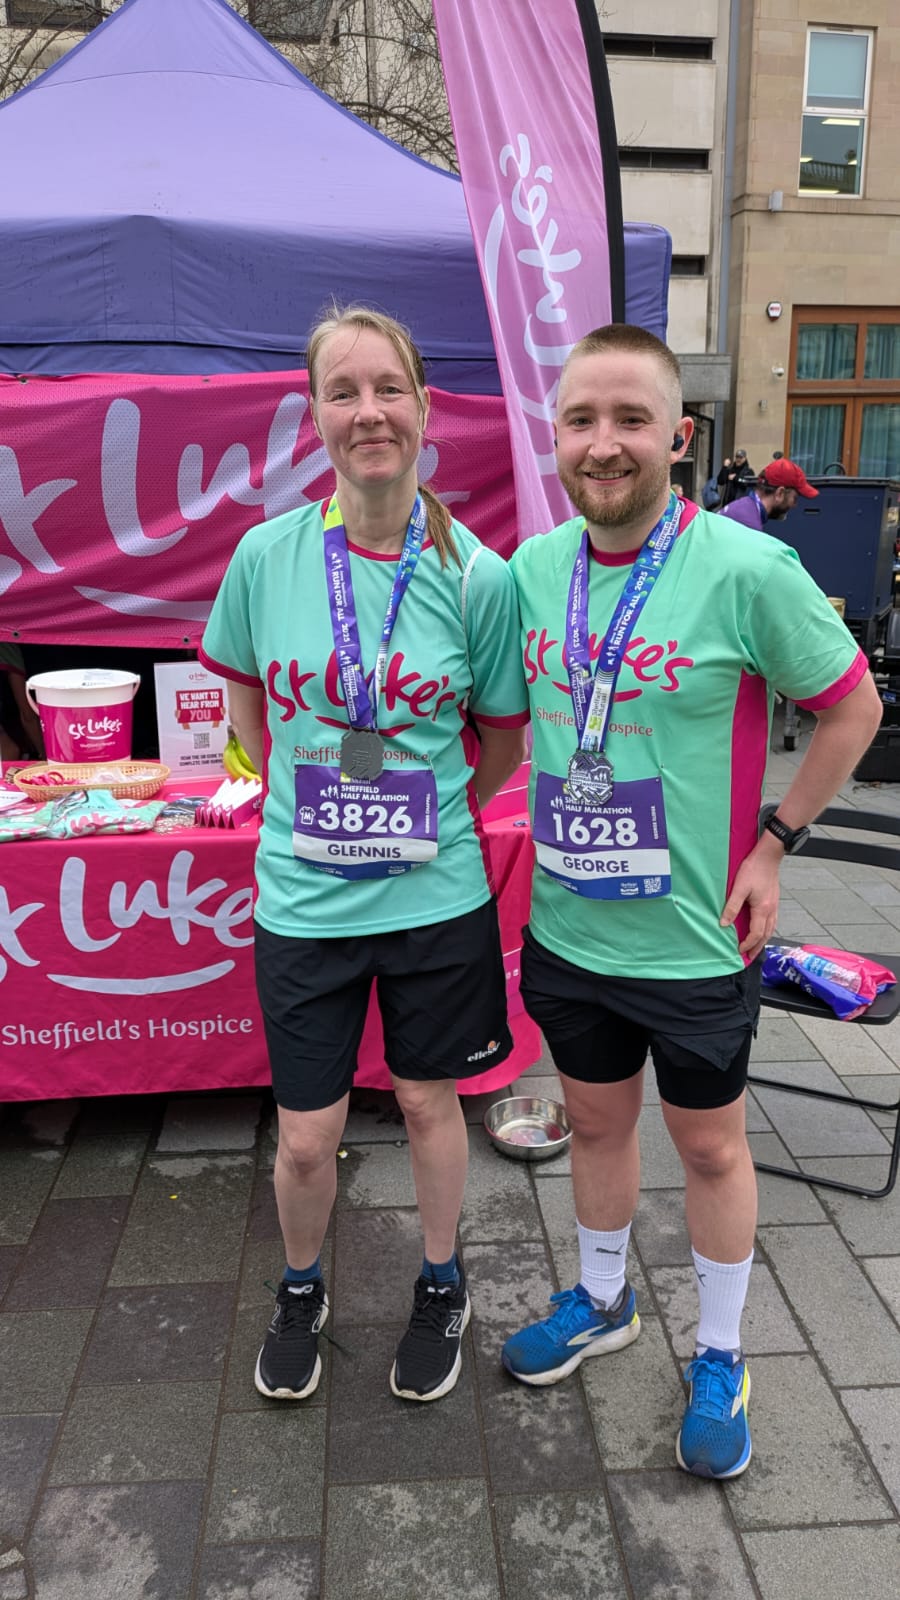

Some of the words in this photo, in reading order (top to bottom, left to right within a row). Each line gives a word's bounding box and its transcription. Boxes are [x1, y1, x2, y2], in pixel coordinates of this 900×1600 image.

[634, 570, 648, 591] 2025
[334, 588, 343, 606] FOR
[631, 594, 641, 609] ALL
[336, 605, 345, 621] ALL
[622, 608, 634, 627] FOR
[341, 623, 351, 643] 2025
[572, 626, 580, 649] 2025
[614, 625, 626, 646] RUN
[524, 628, 559, 684] St
[191, 691, 209, 700] WANT
[210, 691, 220, 700] TO
[267, 659, 318, 722] St
[180, 701, 200, 709] HEAR
[201, 700, 220, 709] FROM
[190, 709, 212, 721] YOU
[68, 723, 86, 740] St
[87, 716, 122, 734] Luke's
[609, 722, 653, 736] ospice
[384, 749, 428, 762] ospice
[341, 784, 379, 794] SHEFFIELD
[362, 794, 410, 802] MARATHON
[565, 804, 582, 812] HALF
[584, 806, 632, 814] MARATHON
[318, 802, 413, 834] 3826
[552, 812, 639, 847] 1628
[327, 843, 402, 859] GLENNIS
[562, 856, 630, 873] GEORGE
[1, 1019, 141, 1050] Sheffield's
[148, 1014, 253, 1041] Hospice
